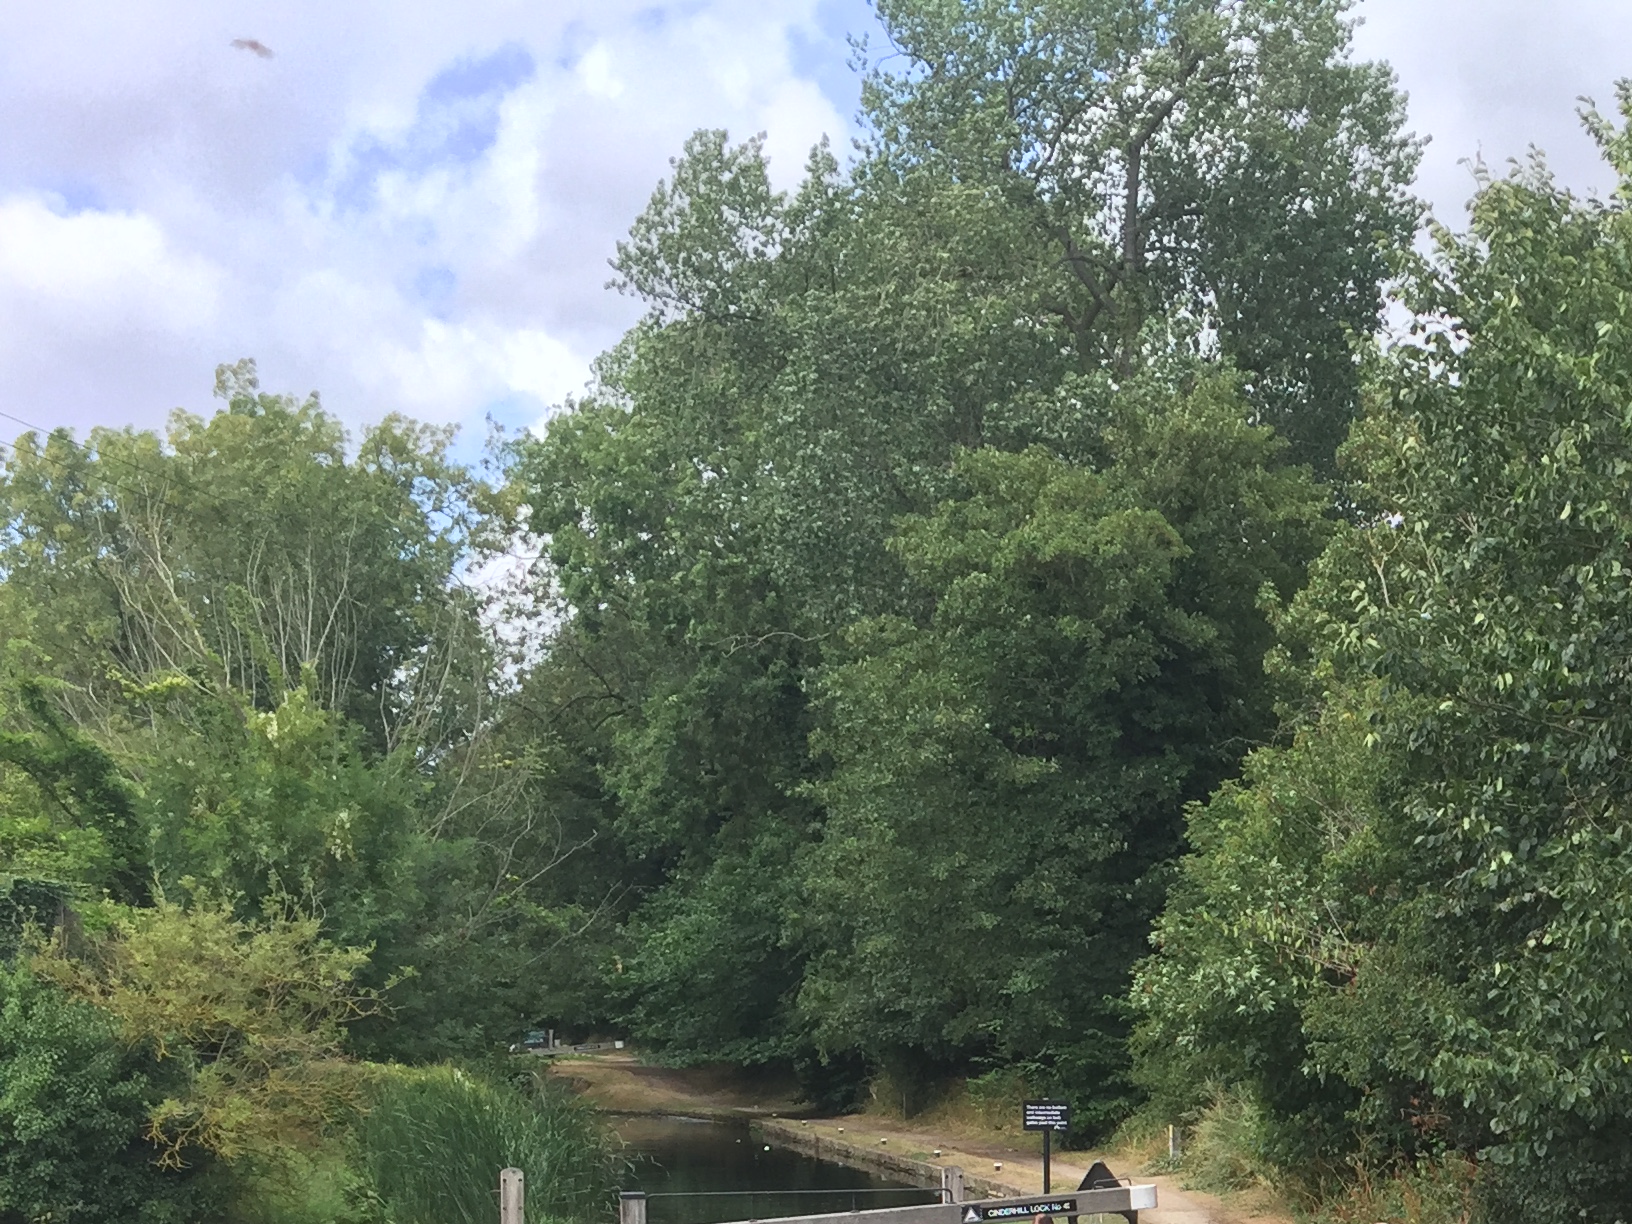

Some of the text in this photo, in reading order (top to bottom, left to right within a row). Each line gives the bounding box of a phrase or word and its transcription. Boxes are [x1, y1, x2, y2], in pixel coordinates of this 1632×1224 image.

[987, 1206, 1030, 1217] CINDERHILL
[1030, 1203, 1051, 1213] LOCK
[1052, 1203, 1062, 1211] No
